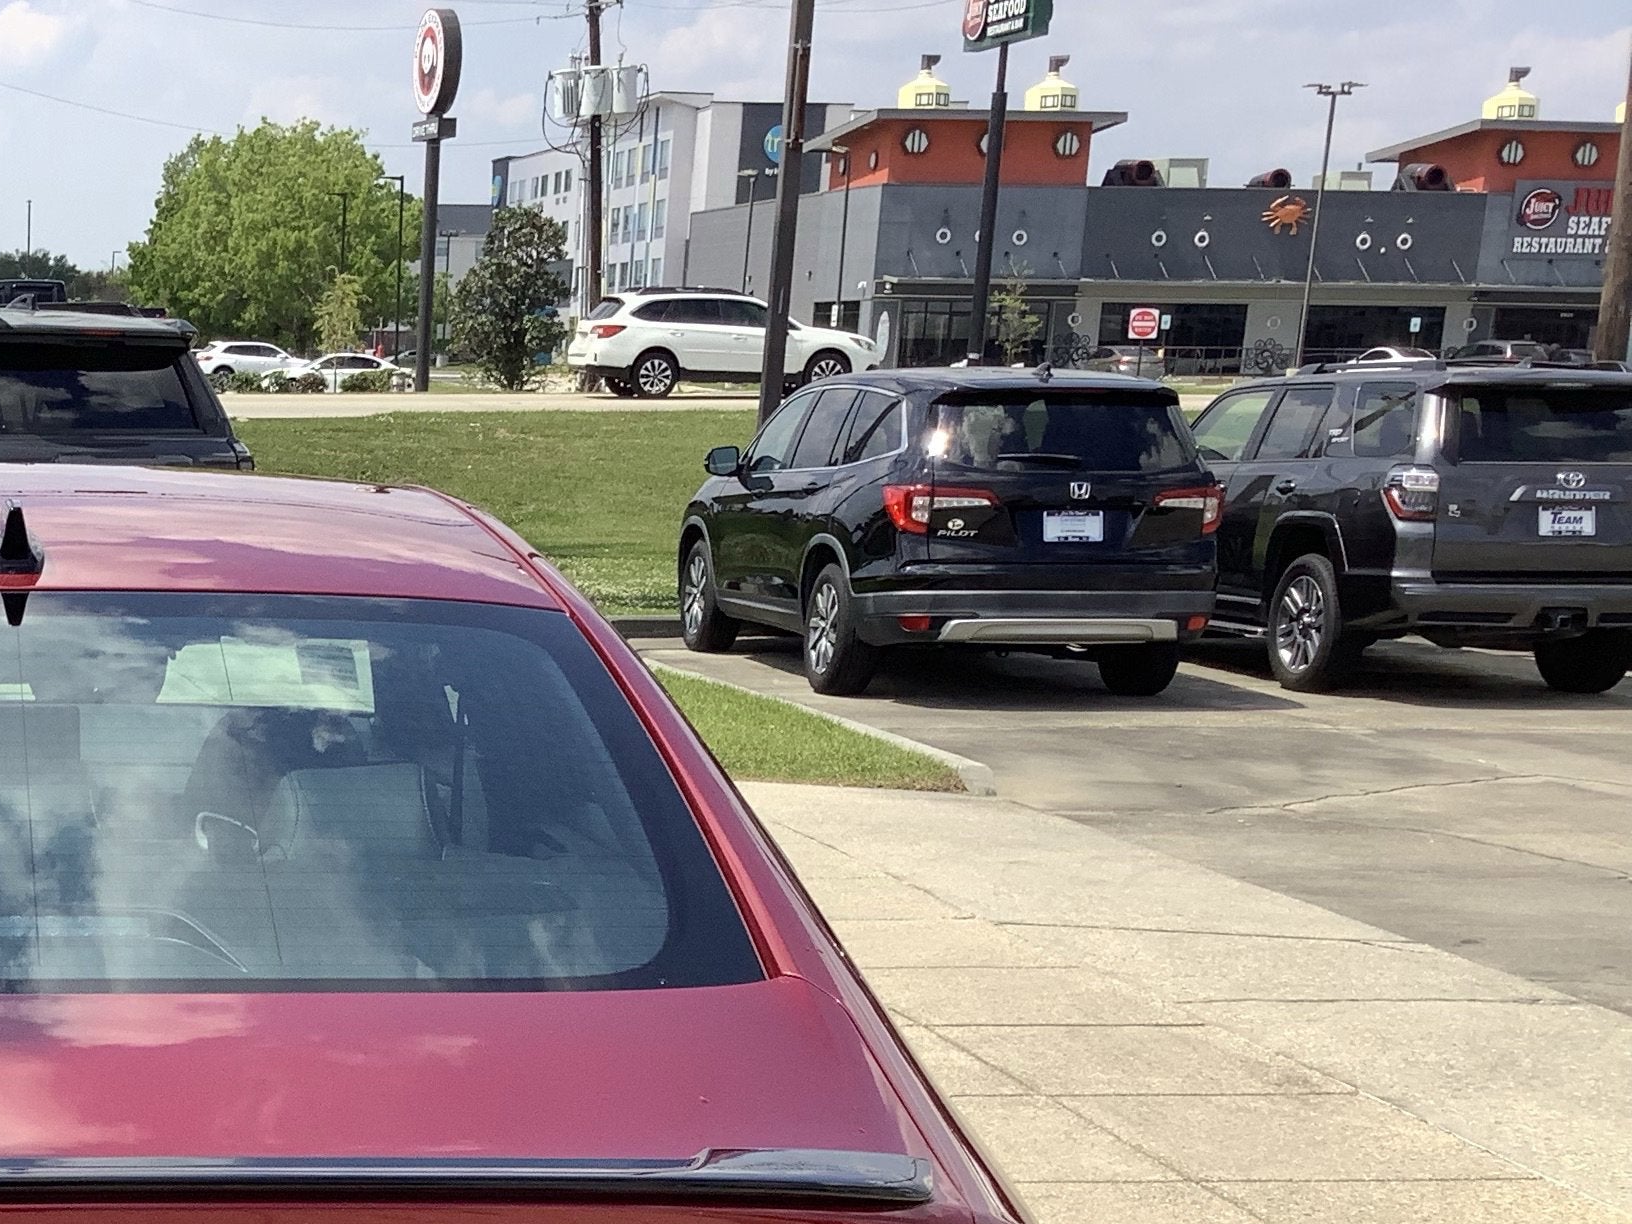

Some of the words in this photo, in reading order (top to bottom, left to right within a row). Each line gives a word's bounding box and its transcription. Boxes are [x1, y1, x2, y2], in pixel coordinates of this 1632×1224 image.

[987, 0, 1027, 22] SEAFOOD
[1513, 237, 1602, 254] RESTAURANT
[937, 529, 978, 537] PILOT
